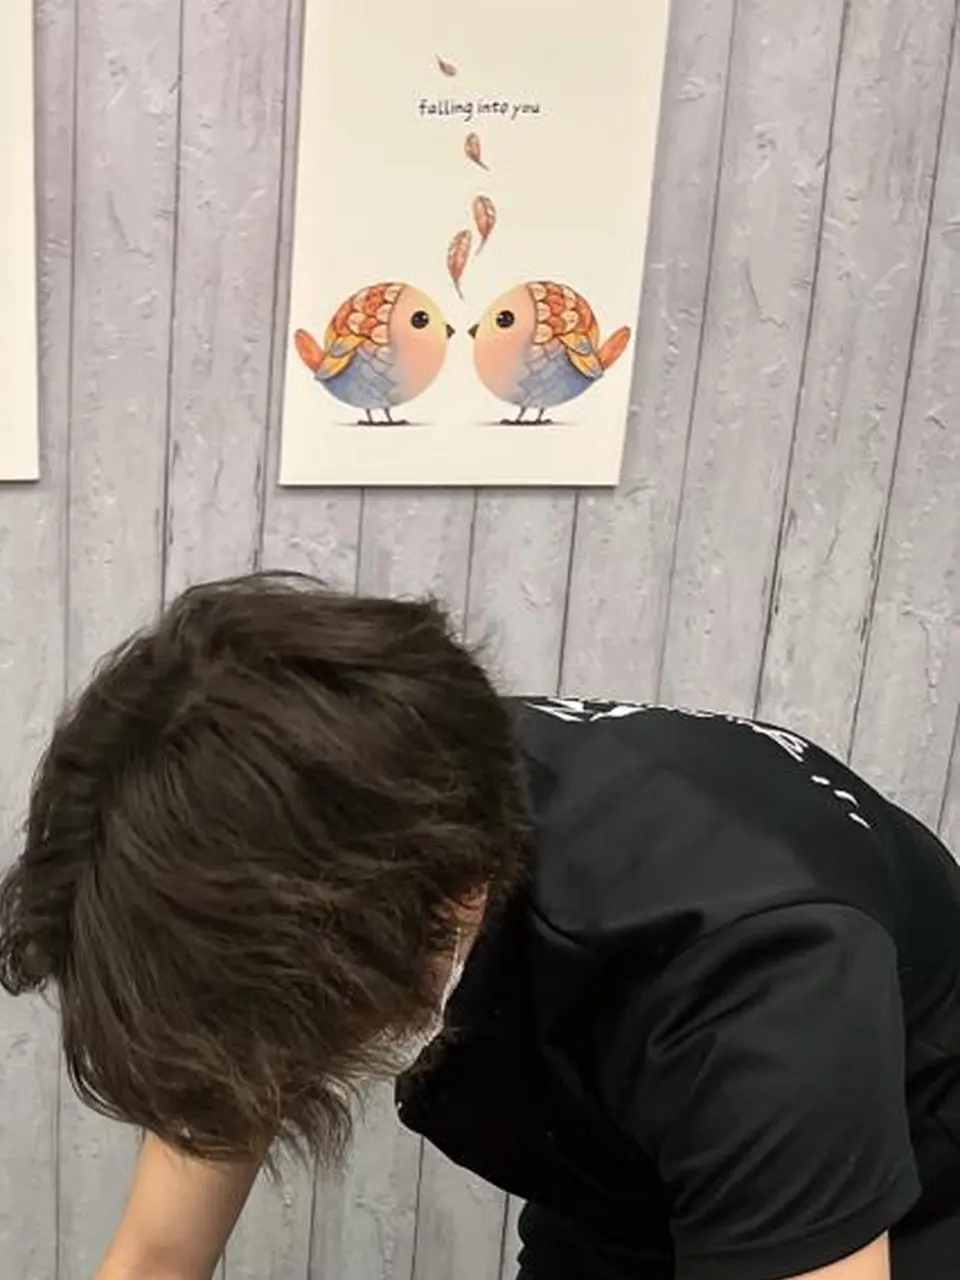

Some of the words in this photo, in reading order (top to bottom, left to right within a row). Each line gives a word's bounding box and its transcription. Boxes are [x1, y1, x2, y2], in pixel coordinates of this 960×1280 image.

[419, 99, 473, 121] falling
[477, 100, 509, 115] into
[511, 104, 540, 120] you
